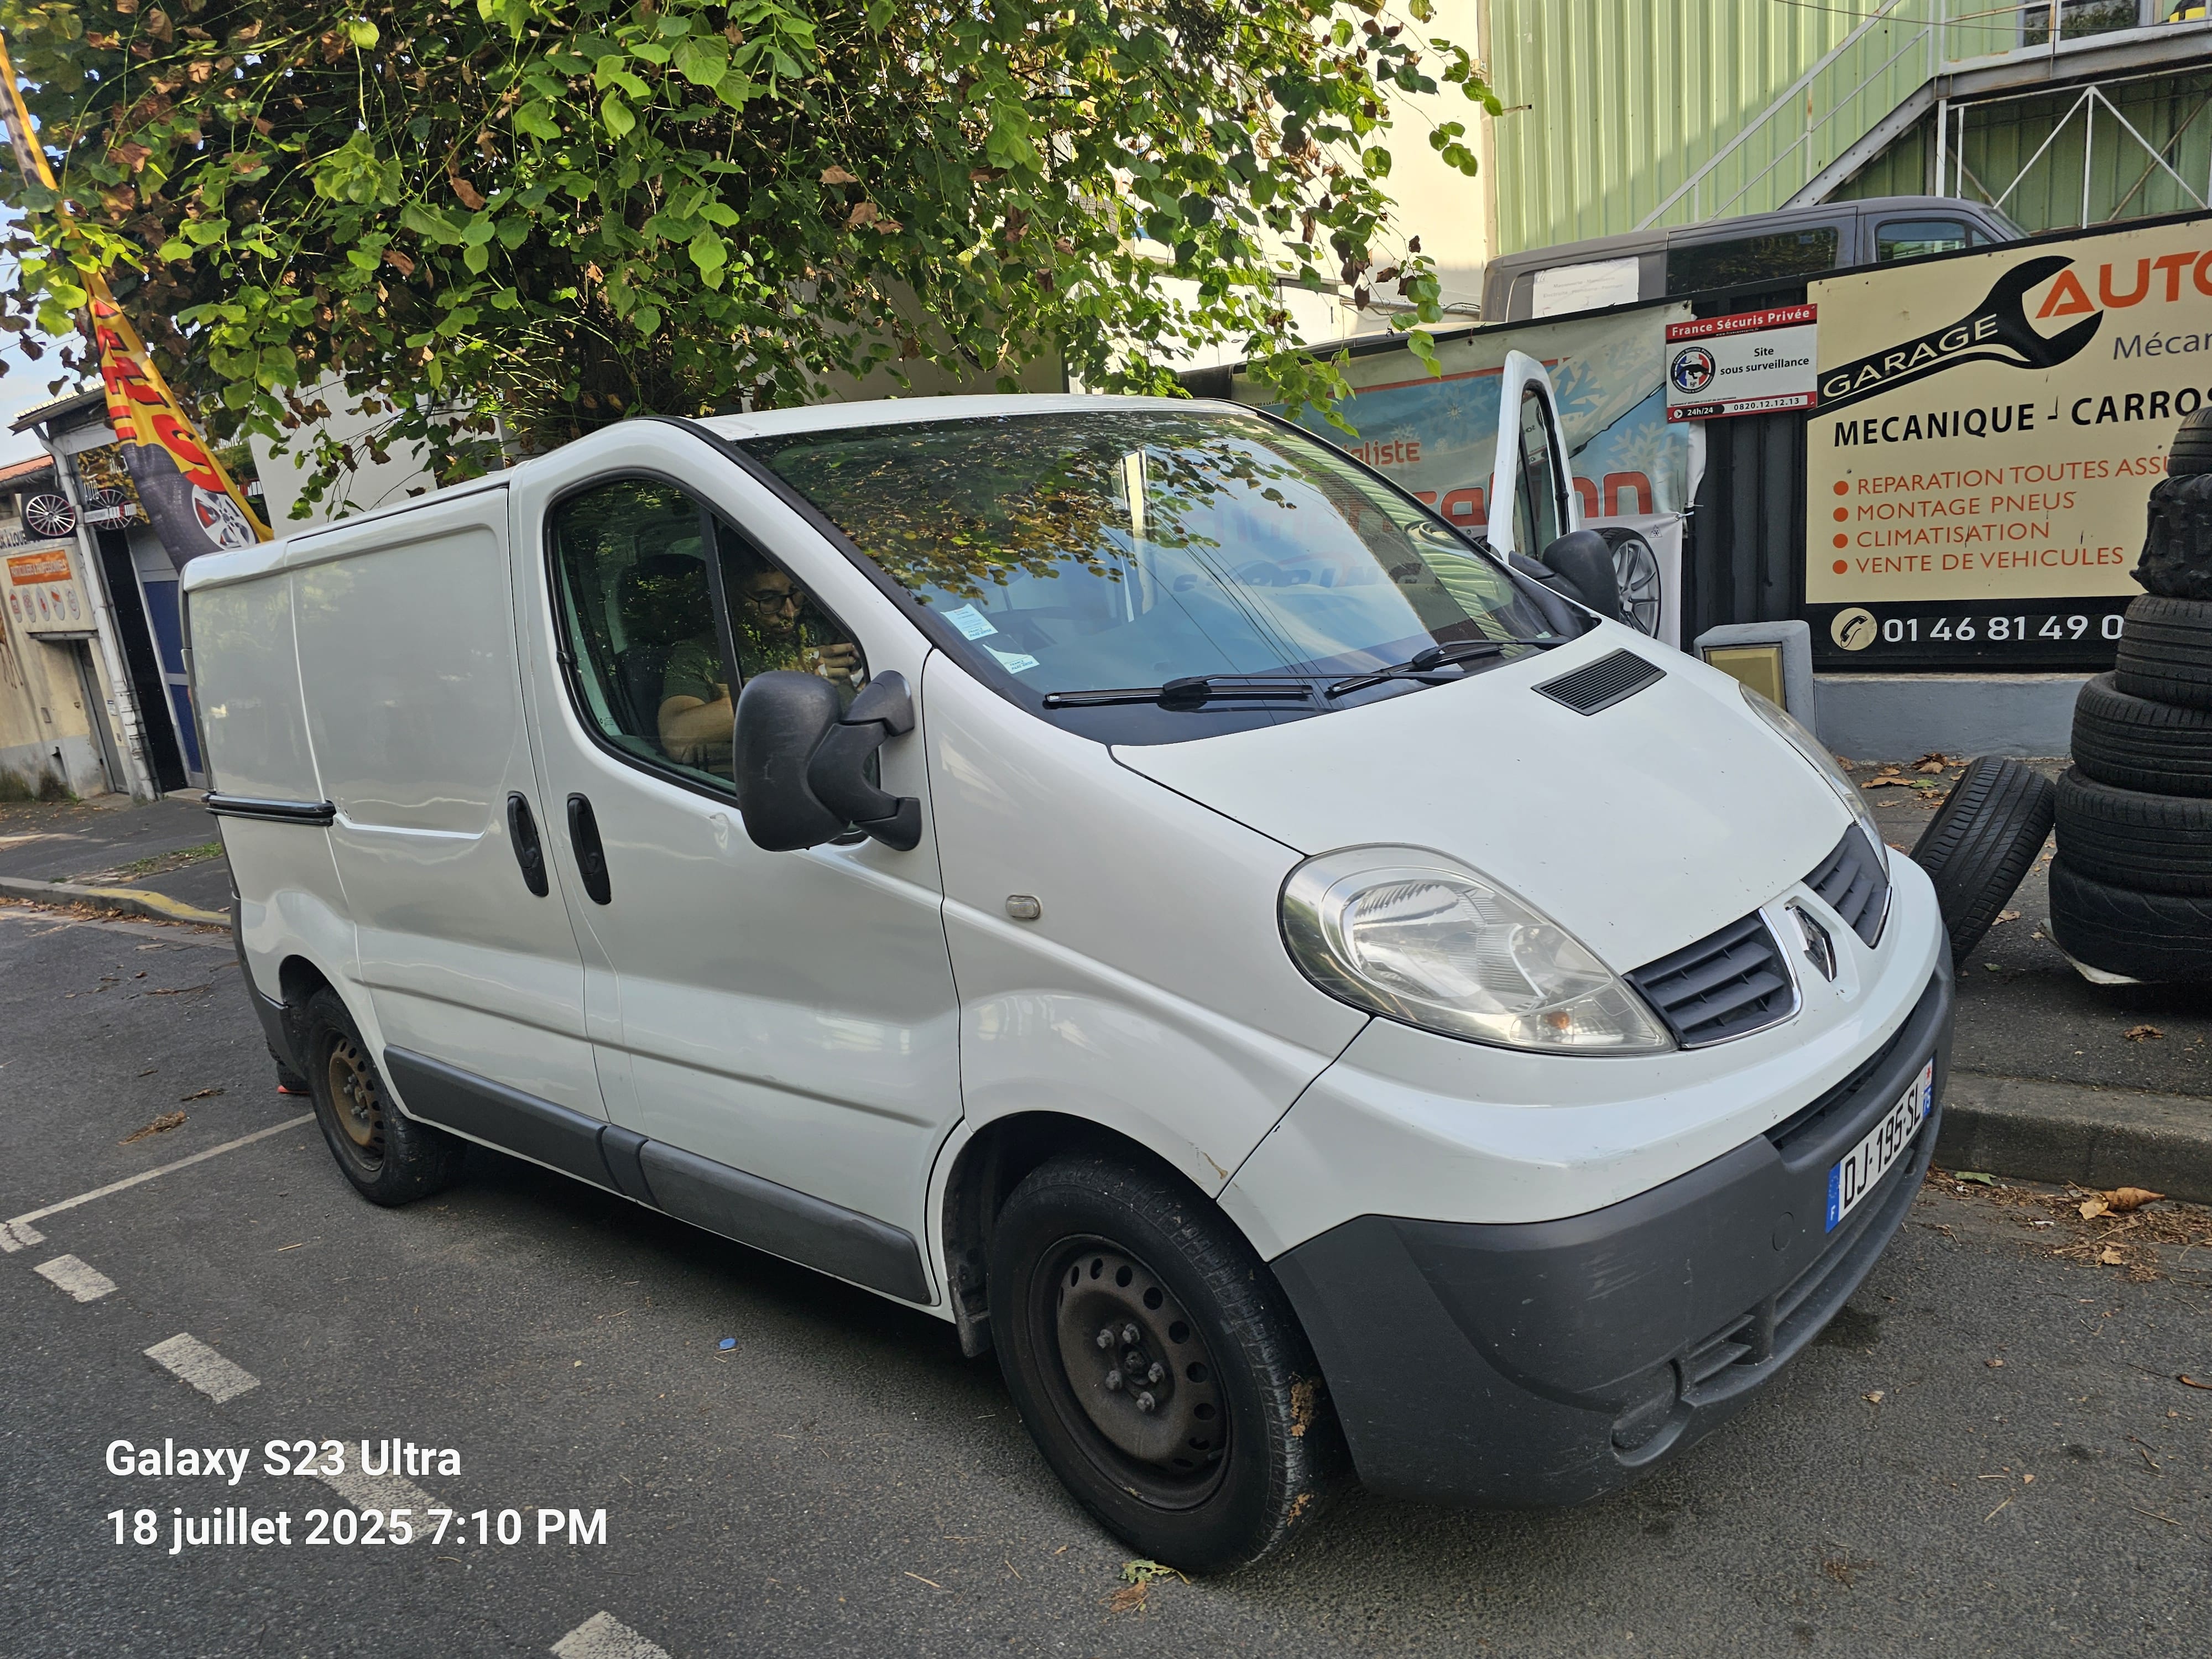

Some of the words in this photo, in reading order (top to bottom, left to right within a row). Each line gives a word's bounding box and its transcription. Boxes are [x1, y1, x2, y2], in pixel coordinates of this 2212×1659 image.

[1672, 324, 1713, 337] France
[1717, 315, 1764, 330] Sécuris
[1768, 309, 1810, 322] Privée
[1720, 366, 1744, 375] sous
[1745, 357, 1809, 373] surveillance
[1754, 347, 1774, 357] Site
[1823, 313, 1998, 397] GARAGE
[1687, 406, 1714, 416] 24h/24
[1734, 398, 1799, 410] 0820.12.12.13
[1834, 403, 2034, 447] MECANIQUE
[1858, 468, 2003, 495] REPARATION
[2010, 460, 2109, 483] TOUTES
[2115, 455, 2168, 477] ASS
[1857, 498, 1980, 521] MONTAGE
[1991, 491, 2077, 513] PNEUS
[1856, 521, 2049, 547] CLIMATISATION
[1856, 555, 1932, 573] VENTE
[1942, 553, 1974, 570] DE
[1979, 547, 2124, 568] VEHICULES
[1884, 618, 1918, 643] 01
[1929, 617, 1976, 641] 46
[1987, 615, 2026, 640] 81
[2038, 615, 2089, 640] 49
[1843, 1082, 1921, 1210] DJ-195-SL
[1830, 1204, 1836, 1221] F
